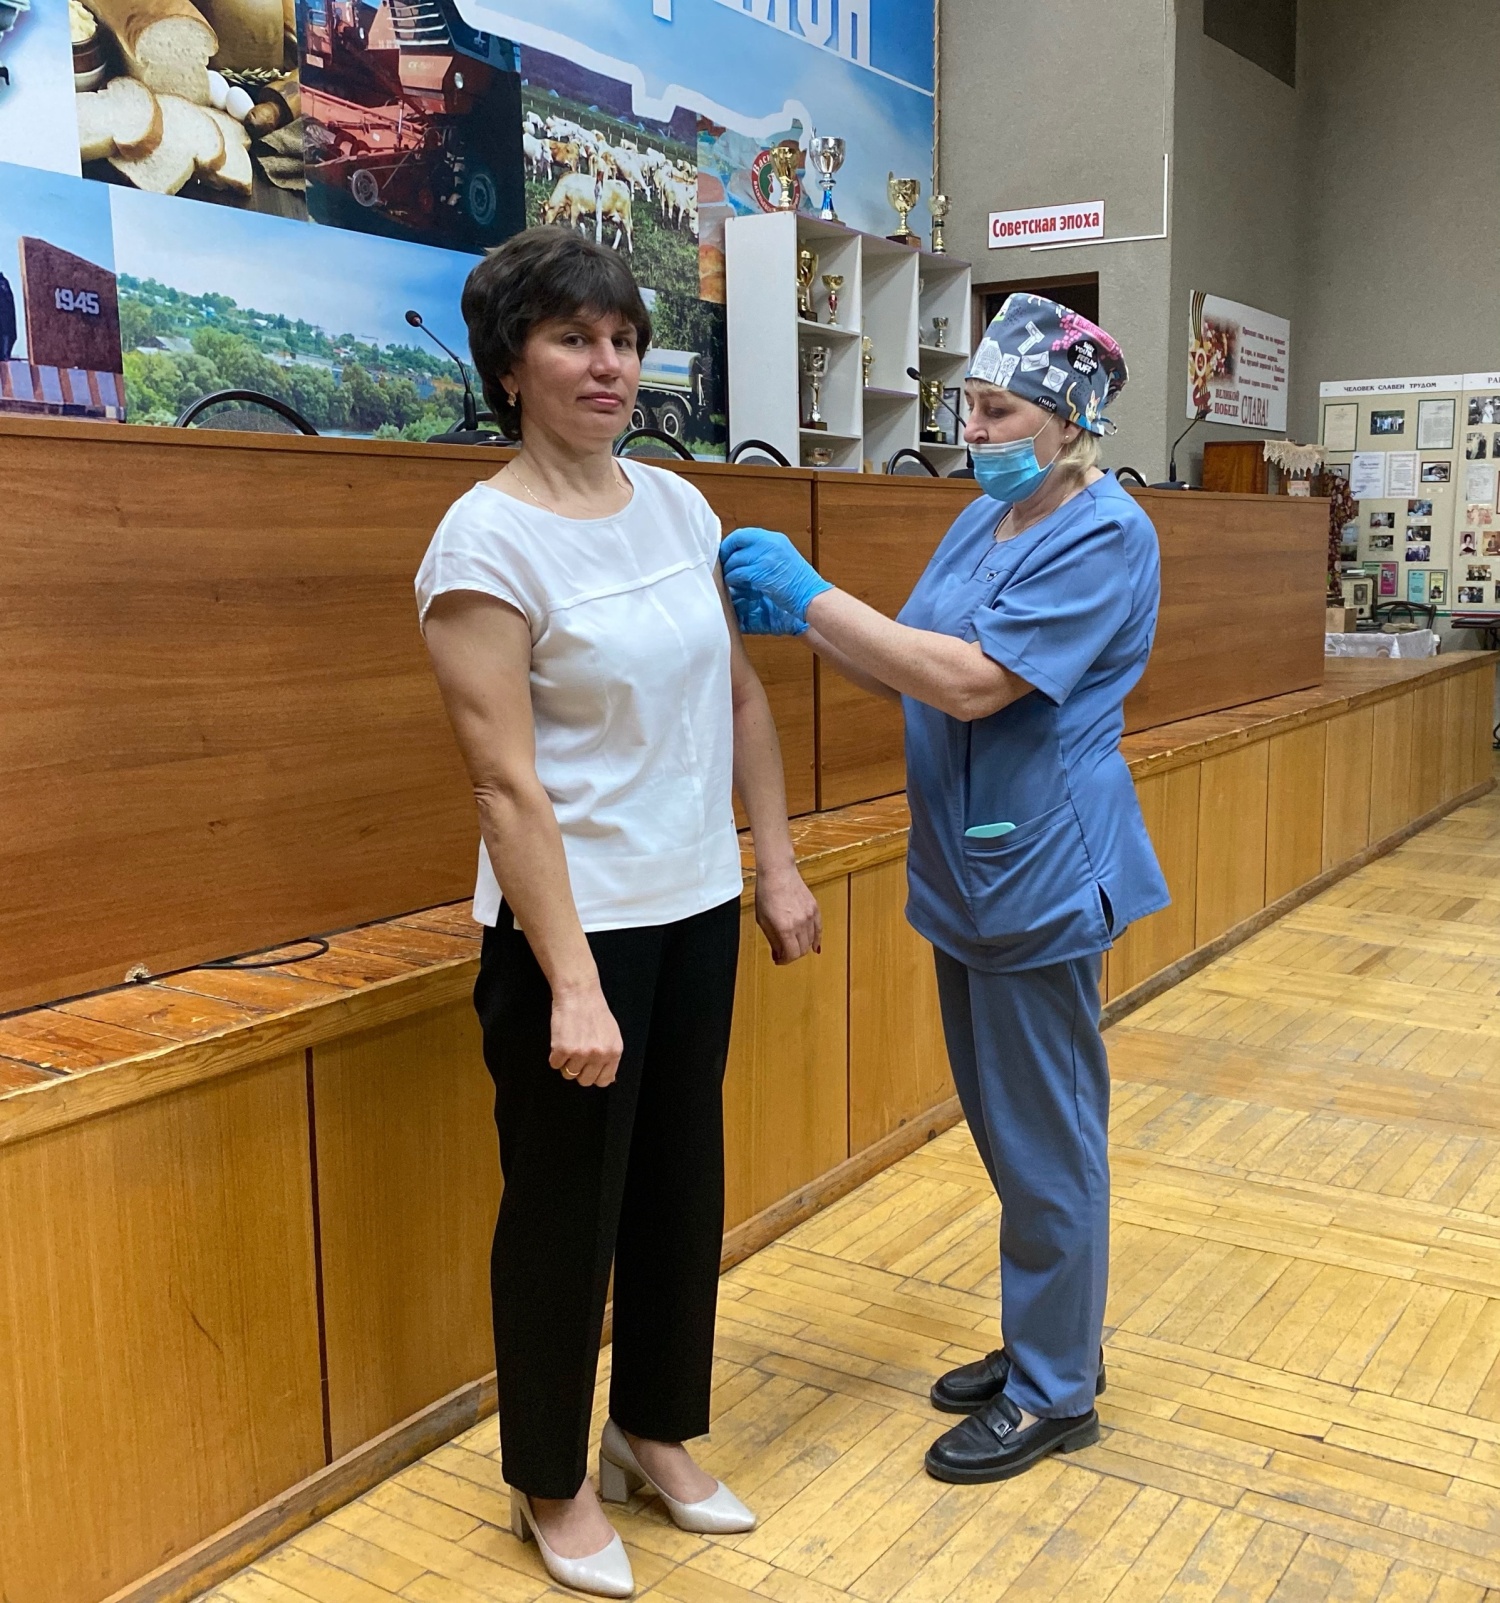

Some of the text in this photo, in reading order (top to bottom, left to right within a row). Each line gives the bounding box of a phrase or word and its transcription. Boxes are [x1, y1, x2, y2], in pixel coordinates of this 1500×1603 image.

[992, 211, 1100, 238] Советская эпоха
[54, 287, 100, 315] 1945
[1343, 381, 1437, 393] ЧЕЛОВЕК СЛАВЕН ТРУДОМ
[1487, 376, 1500, 384] РА
[1041, 398, 1057, 410] HAVE
[1214, 402, 1239, 417] ПОБЕДЕ
[1241, 394, 1269, 427] СЛАВА!
